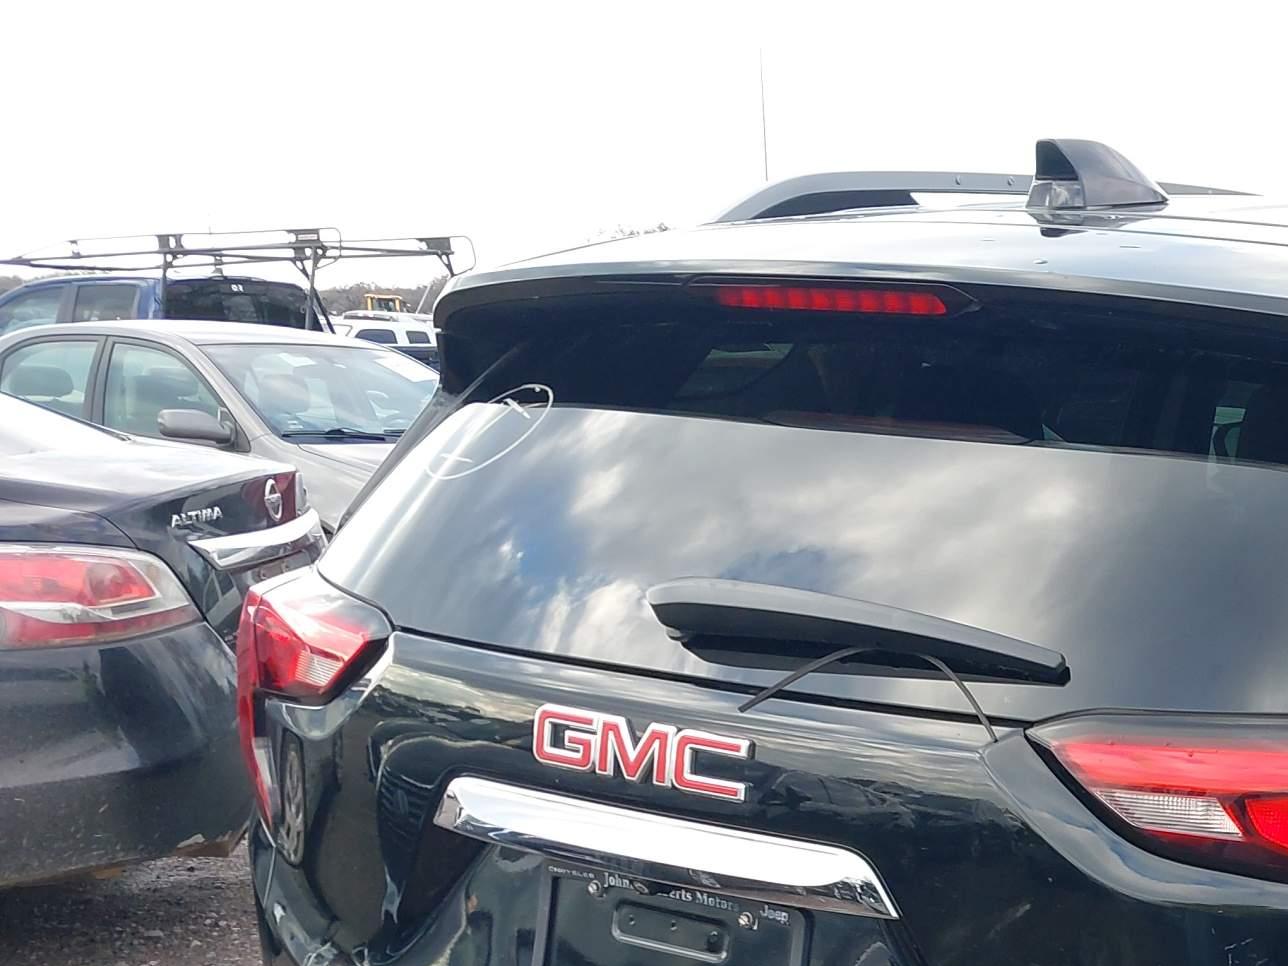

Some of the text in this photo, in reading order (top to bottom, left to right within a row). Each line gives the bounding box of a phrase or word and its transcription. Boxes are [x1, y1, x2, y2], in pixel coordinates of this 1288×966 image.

[171, 506, 223, 528] ALTIMA
[533, 703, 750, 802] GMC
[603, 872, 630, 888] John
[695, 891, 740, 912] Motors
[759, 904, 789, 923] Jeep
